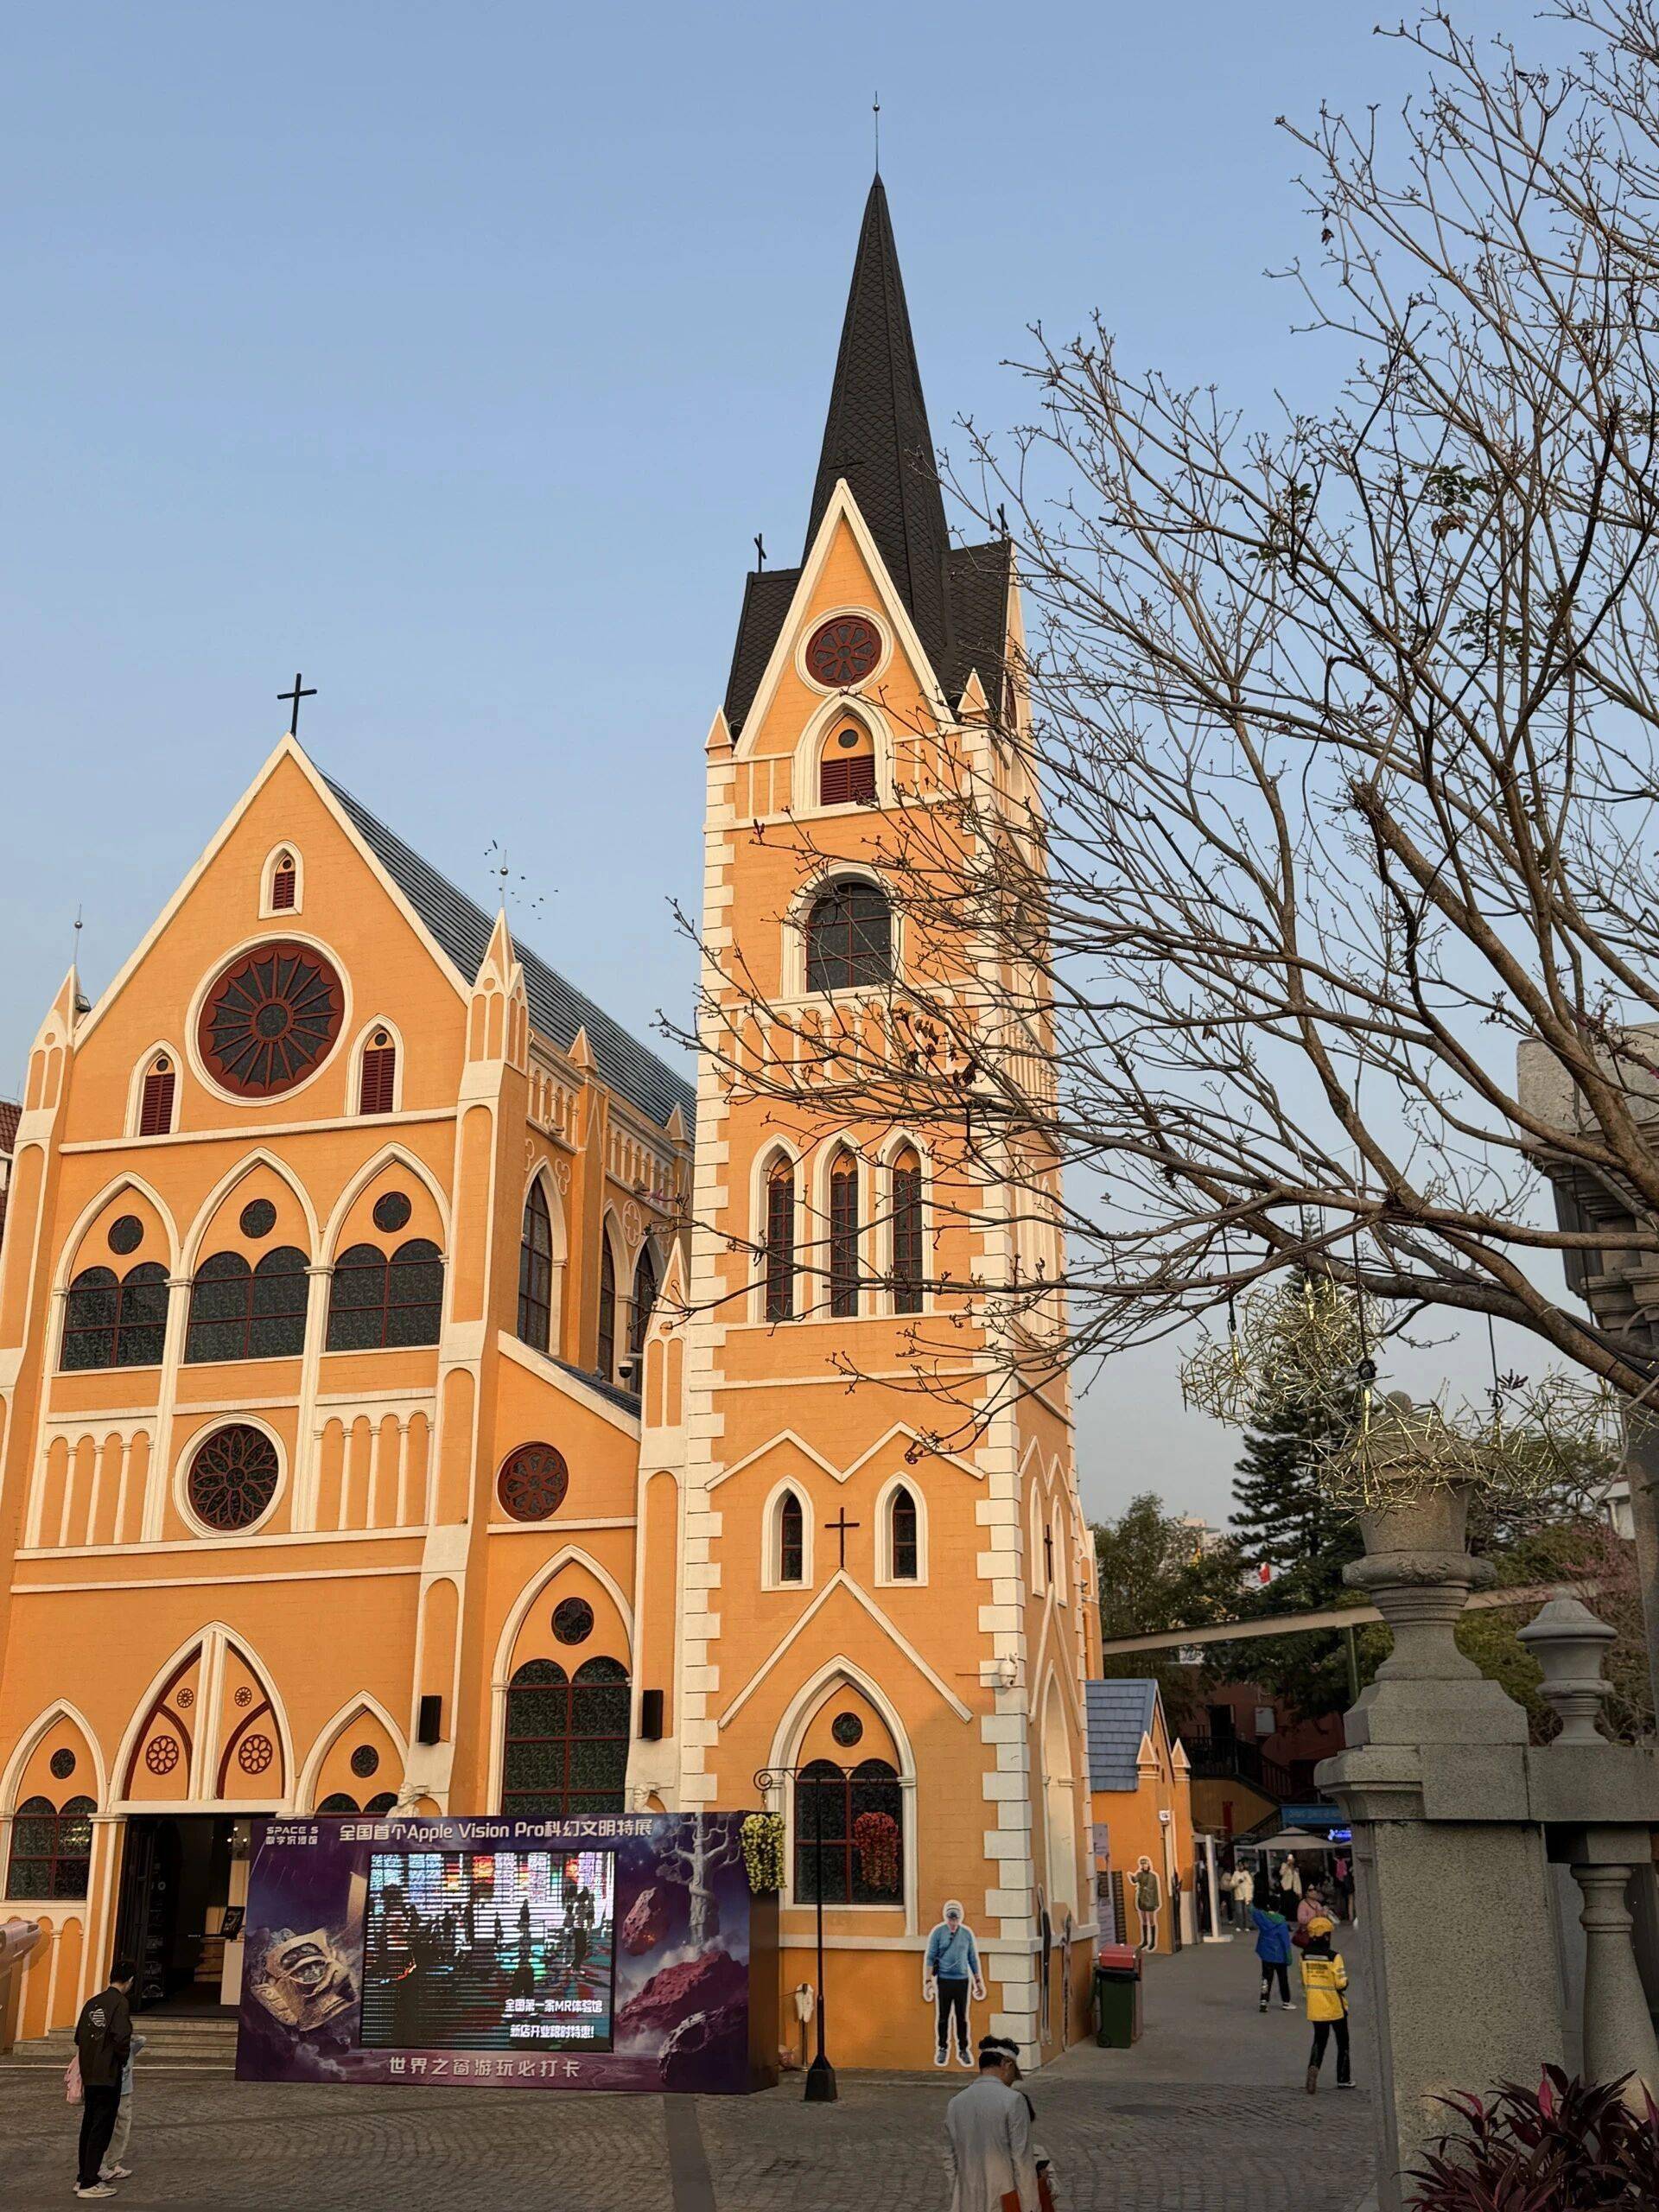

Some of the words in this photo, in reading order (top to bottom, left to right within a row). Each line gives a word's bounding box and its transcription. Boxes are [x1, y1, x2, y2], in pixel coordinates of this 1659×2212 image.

[266, 1826, 307, 1834] SPACE
[310, 1826, 319, 1834] S
[339, 1823, 453, 1843] 全国首个Apple
[458, 1822, 510, 1840] Vision
[514, 1819, 653, 1838] Pro科幻文明特展
[504, 1998, 603, 2013] 全国第一家MR体验馆
[389, 2056, 580, 2077] 世界之窗游玩必打卡
